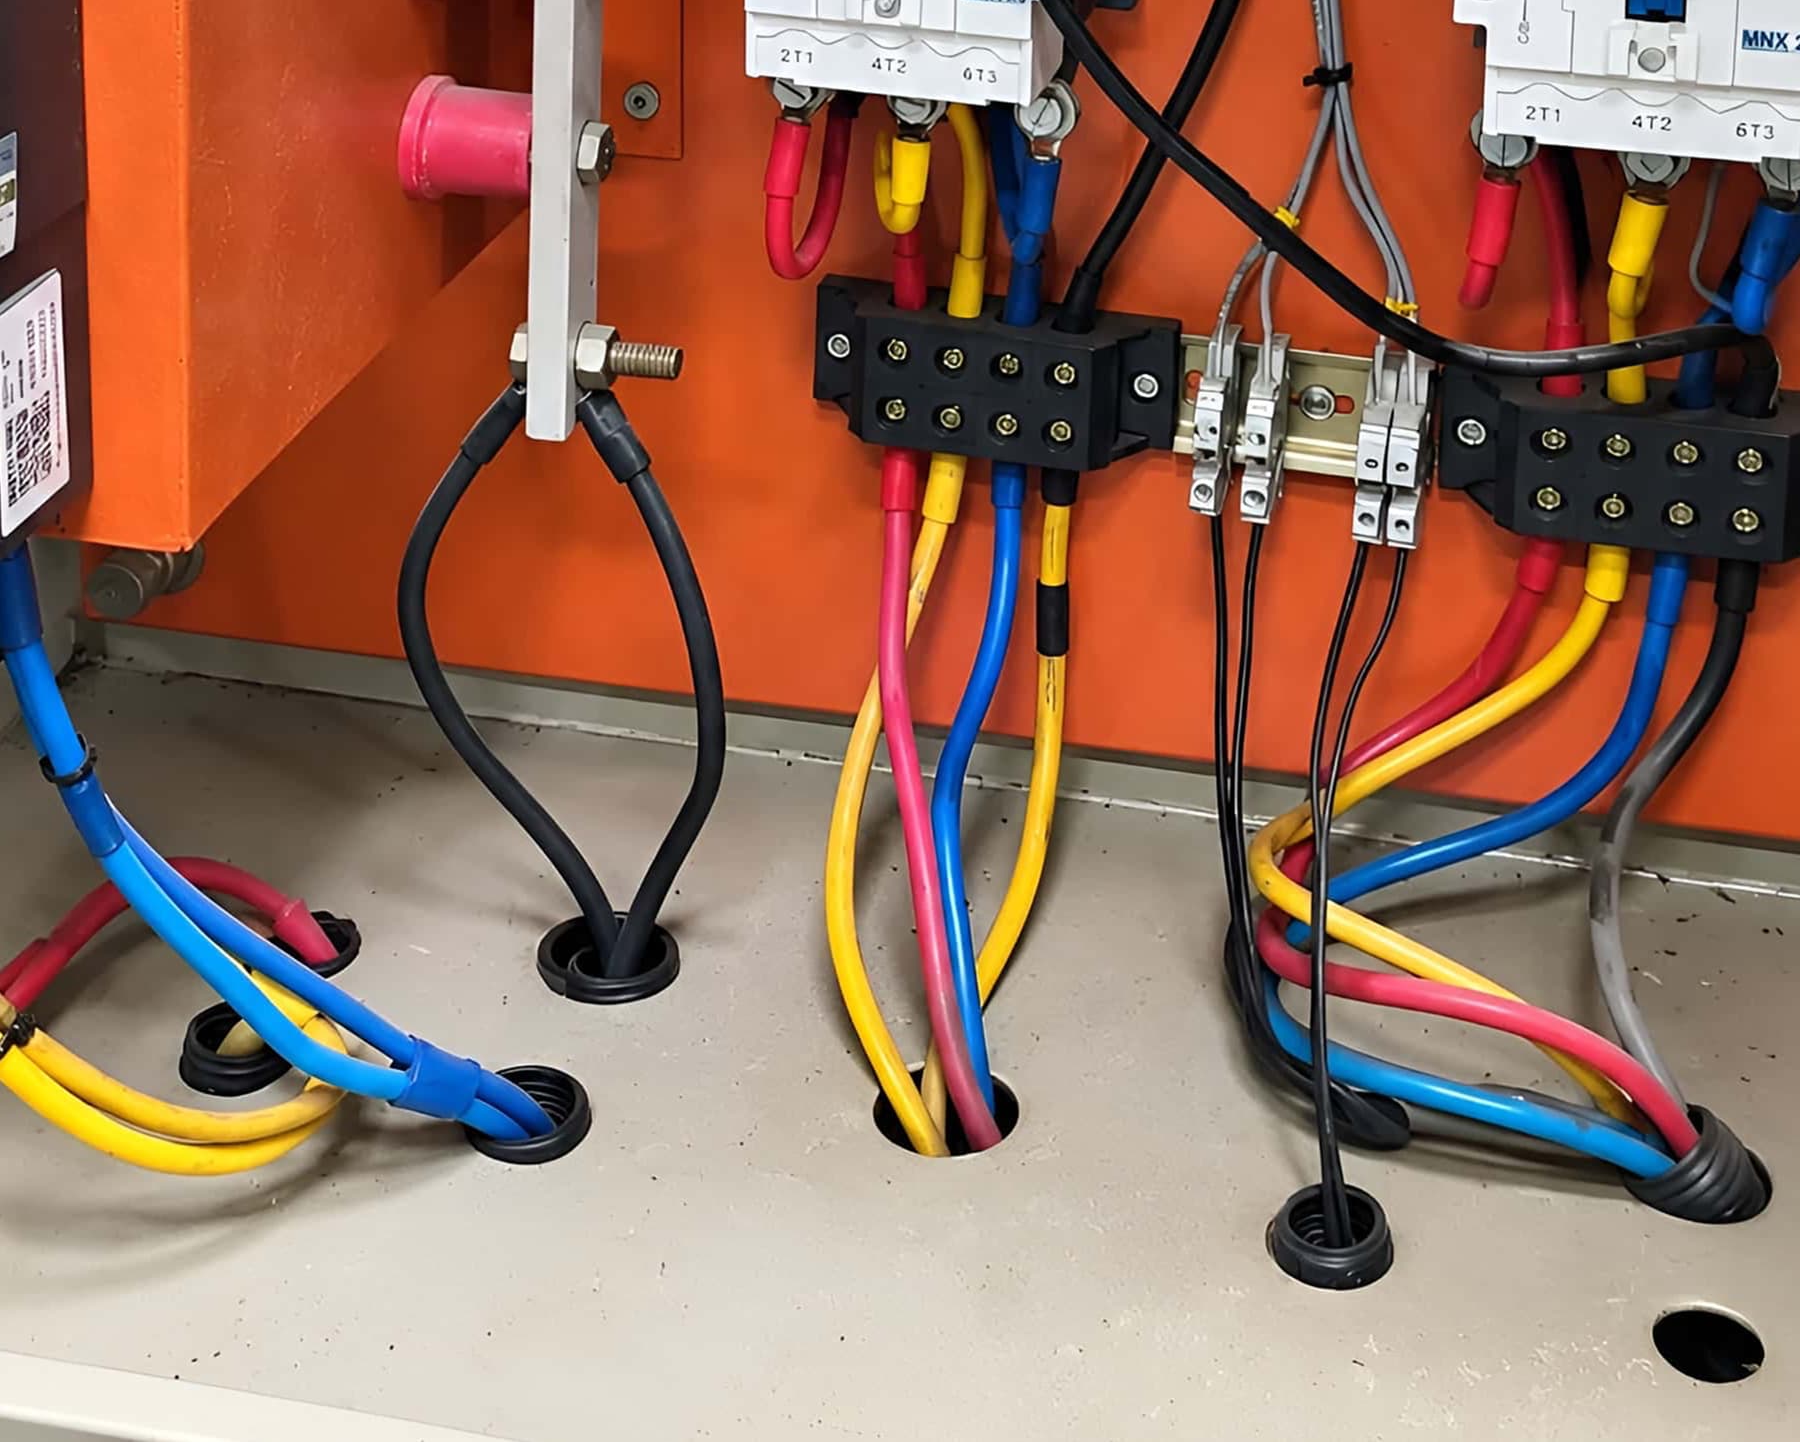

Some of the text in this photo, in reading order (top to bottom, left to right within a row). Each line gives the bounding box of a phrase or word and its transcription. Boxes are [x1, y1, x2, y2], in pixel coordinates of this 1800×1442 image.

[1742, 29, 1789, 52] MNX
[780, 48, 814, 64] 2T1
[871, 57, 907, 75] 4T2
[1525, 105, 1560, 123] 2T1
[1631, 115, 1672, 132] 4T2
[1736, 122, 1774, 140] 6T3
